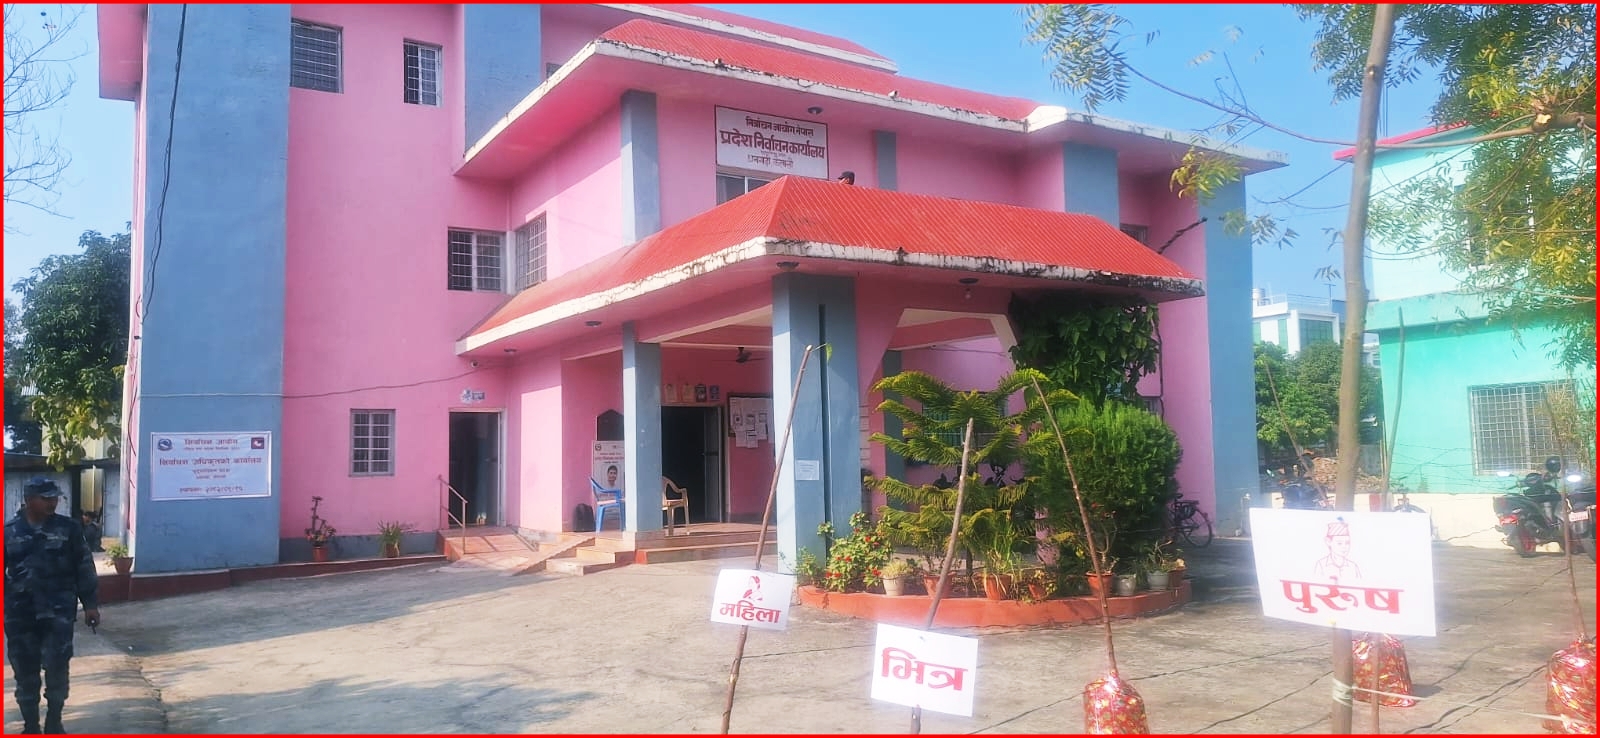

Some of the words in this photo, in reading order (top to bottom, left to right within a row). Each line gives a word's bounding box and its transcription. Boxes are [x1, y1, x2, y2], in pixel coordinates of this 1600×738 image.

[745, 116, 772, 130] निर्वाचन
[773, 121, 795, 134] आयोग
[796, 124, 814, 137] नेपाल
[719, 128, 753, 147] प्रदेश
[753, 131, 789, 153] निर्वाचन
[789, 140, 825, 159] कार्यालय
[720, 599, 781, 623] महिला
[881, 646, 968, 691] भित्र
